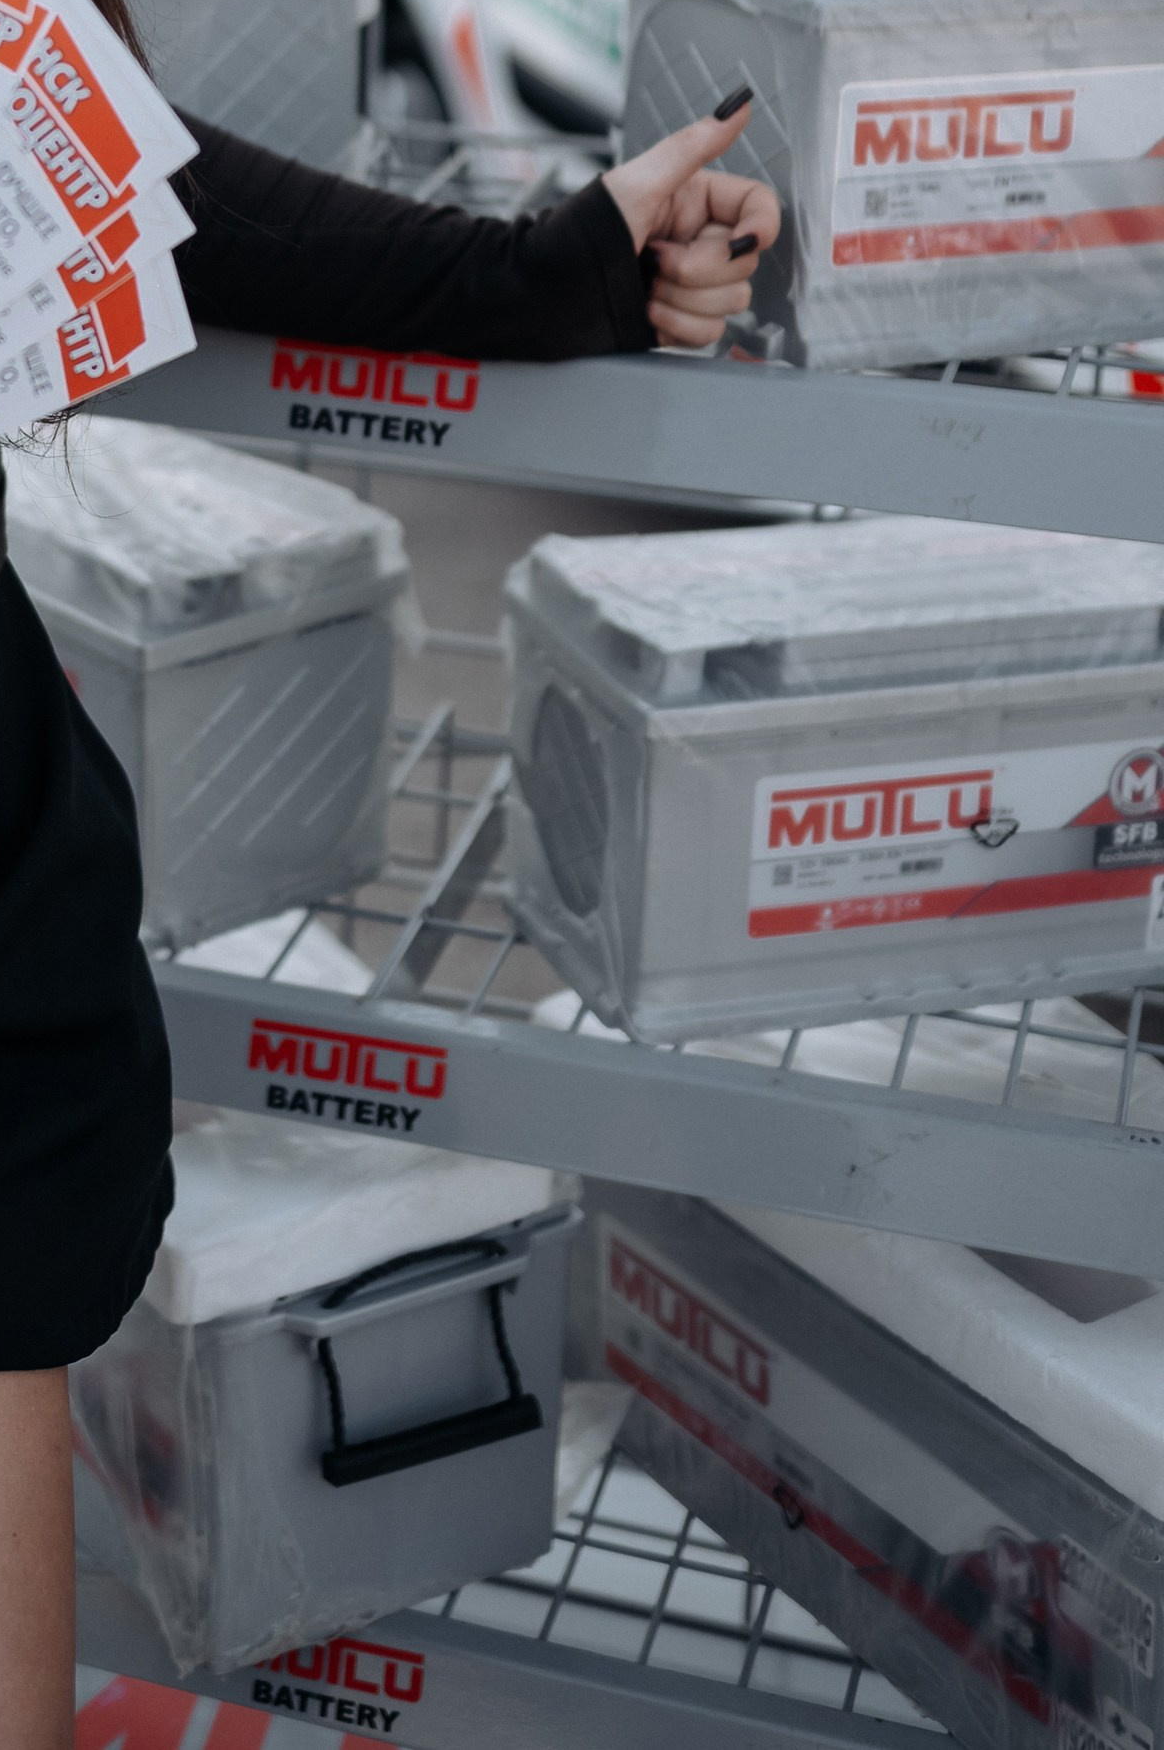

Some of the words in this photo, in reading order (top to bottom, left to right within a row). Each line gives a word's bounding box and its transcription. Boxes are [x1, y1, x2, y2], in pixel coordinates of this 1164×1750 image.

[6, 87, 110, 209] ОЦЕНТР
[854, 89, 1076, 167] MUTLU
[271, 337, 481, 413] MUTLU
[289, 403, 452, 447] BATTERY
[768, 769, 994, 849] MUTLU
[1113, 821, 1158, 846] SFB
[248, 1019, 448, 1099] MUTLU
[266, 1084, 422, 1132] BATTERY
[610, 1235, 770, 1408] MUTLU
[252, 1678, 401, 1733] BATTERY
